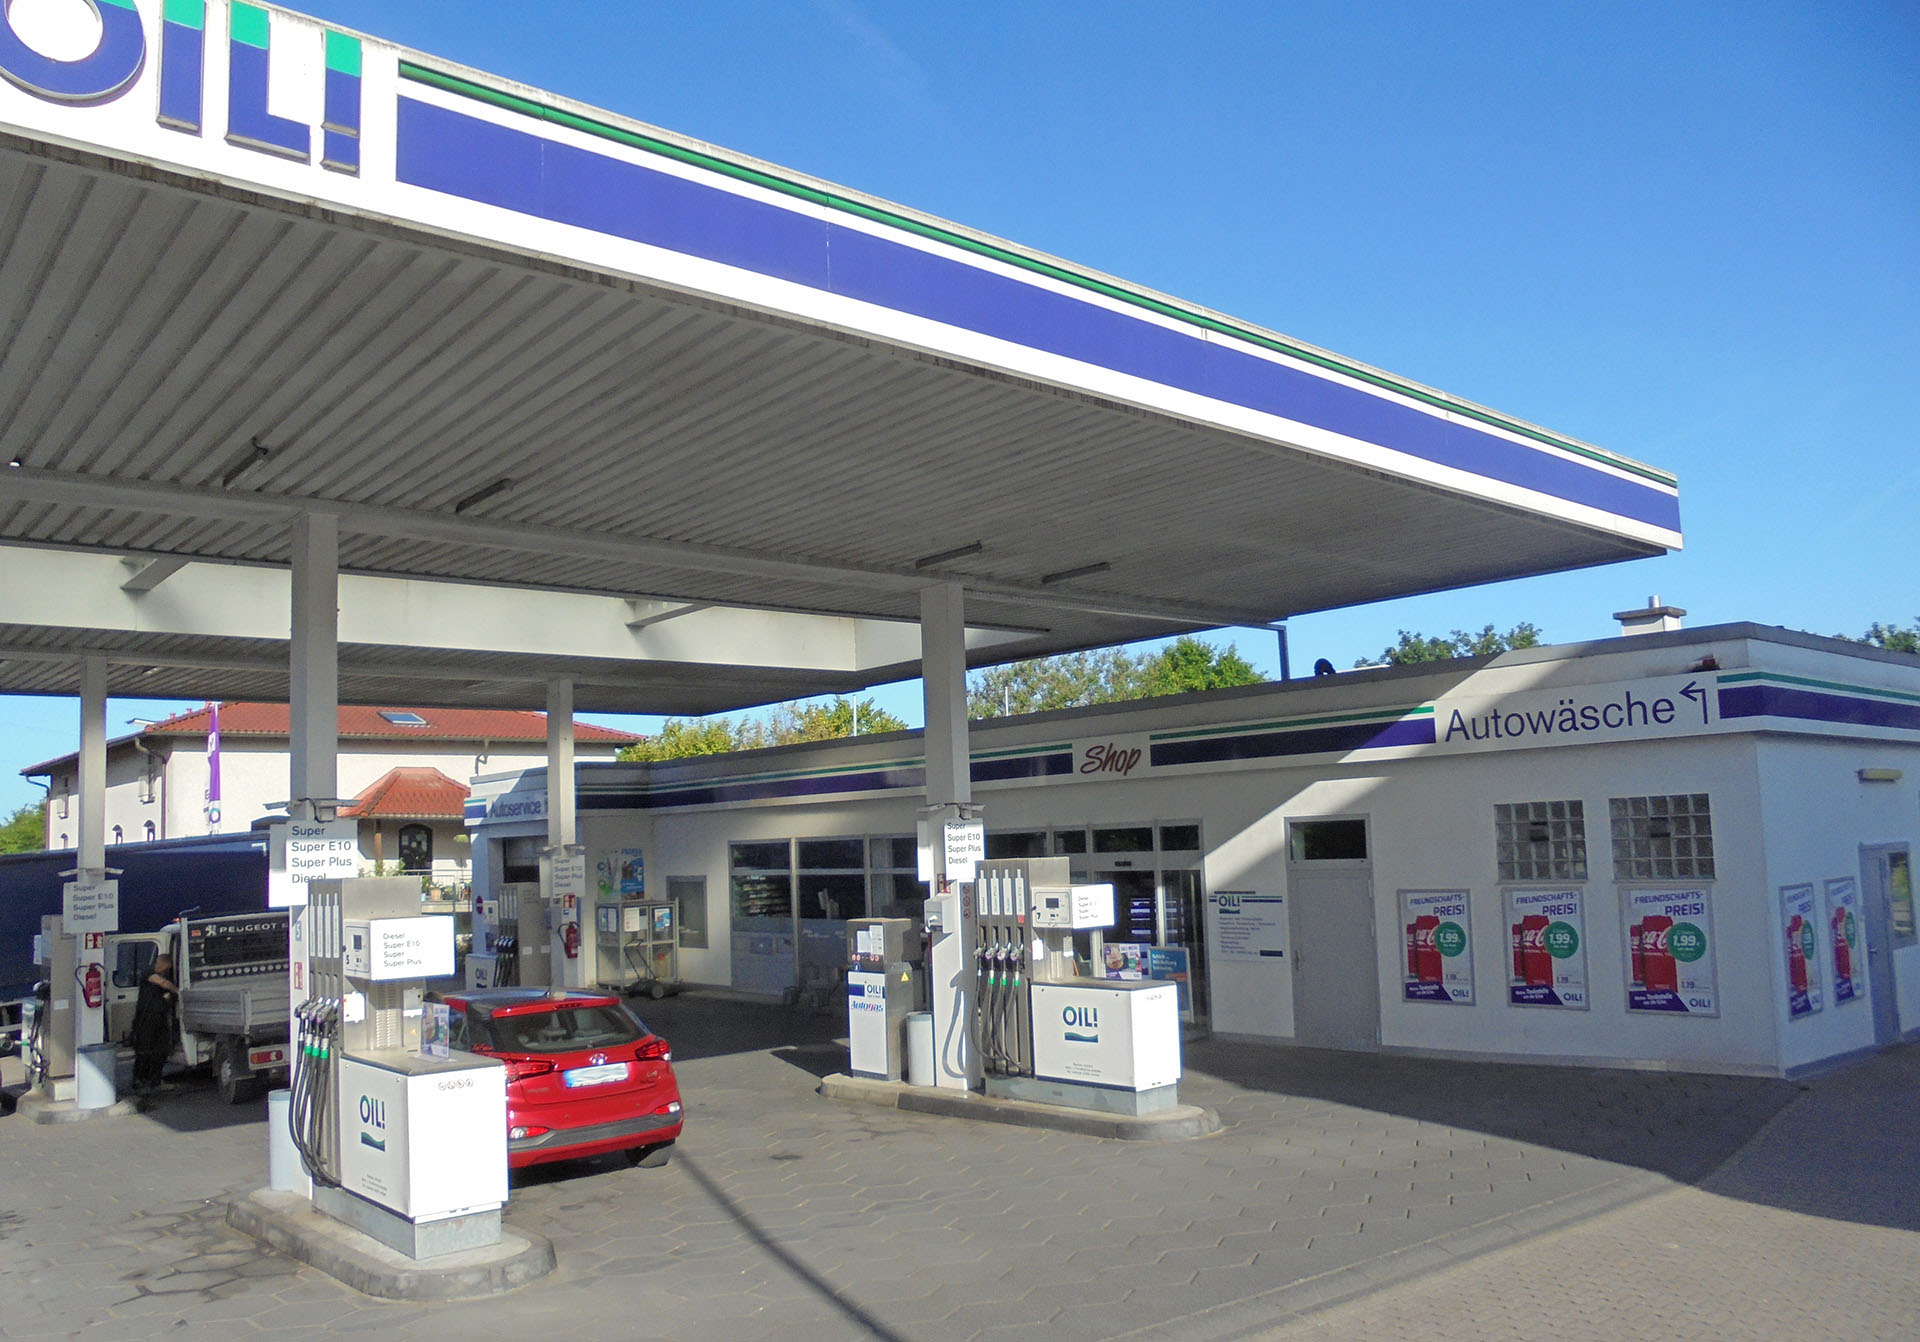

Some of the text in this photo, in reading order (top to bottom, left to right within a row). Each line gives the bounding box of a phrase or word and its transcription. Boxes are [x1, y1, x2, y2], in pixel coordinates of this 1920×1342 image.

[0, 0, 361, 177] OIL!
[1445, 691, 1675, 742] Autowäsche
[1080, 742, 1142, 776] Shop
[291, 825, 326, 837] Super
[947, 823, 966, 831] Super
[947, 834, 966, 843] Super
[291, 840, 351, 853] Super E10
[948, 844, 981, 853] Super Plus
[291, 856, 352, 869] Super Plus
[1219, 895, 1240, 907] OIL!
[1433, 904, 1465, 917] PREIS!
[1542, 903, 1577, 916] PREIS!
[1664, 903, 1704, 917] PREIS!
[220, 922, 277, 934] PEUGEOT
[866, 984, 881, 995] OIL!
[1452, 988, 1470, 998] OIL!
[1563, 992, 1583, 1001] OIL!
[852, 1000, 883, 1012] Autogas
[1689, 998, 1711, 1009] OIL!
[1062, 1005, 1098, 1028] OIL!
[360, 1094, 385, 1129] OIL!
